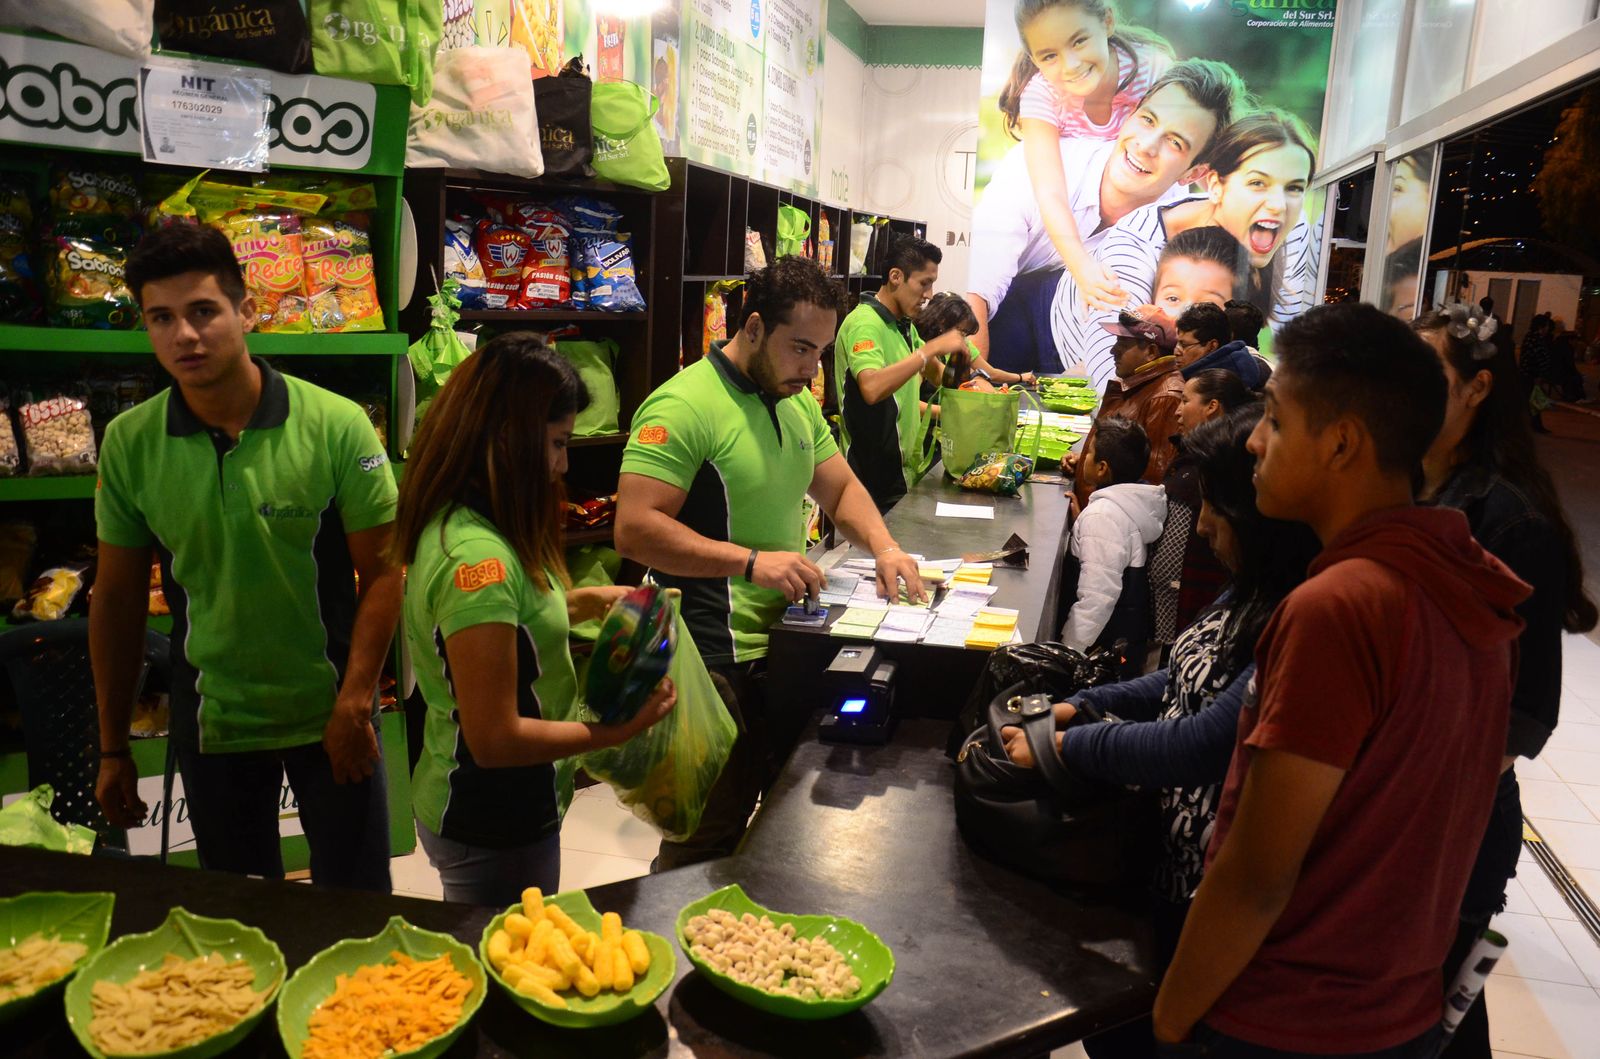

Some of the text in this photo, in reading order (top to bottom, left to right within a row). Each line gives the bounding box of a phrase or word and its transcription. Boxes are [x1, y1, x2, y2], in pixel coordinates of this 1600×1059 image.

[1283, 10, 1296, 20] del
[1298, 10, 1316, 20] Sur
[1288, 20, 1298, 28] de
[1298, 20, 1334, 28] Alimentos
[181, 75, 216, 92] NIT
[172, 101, 223, 115] 176302029
